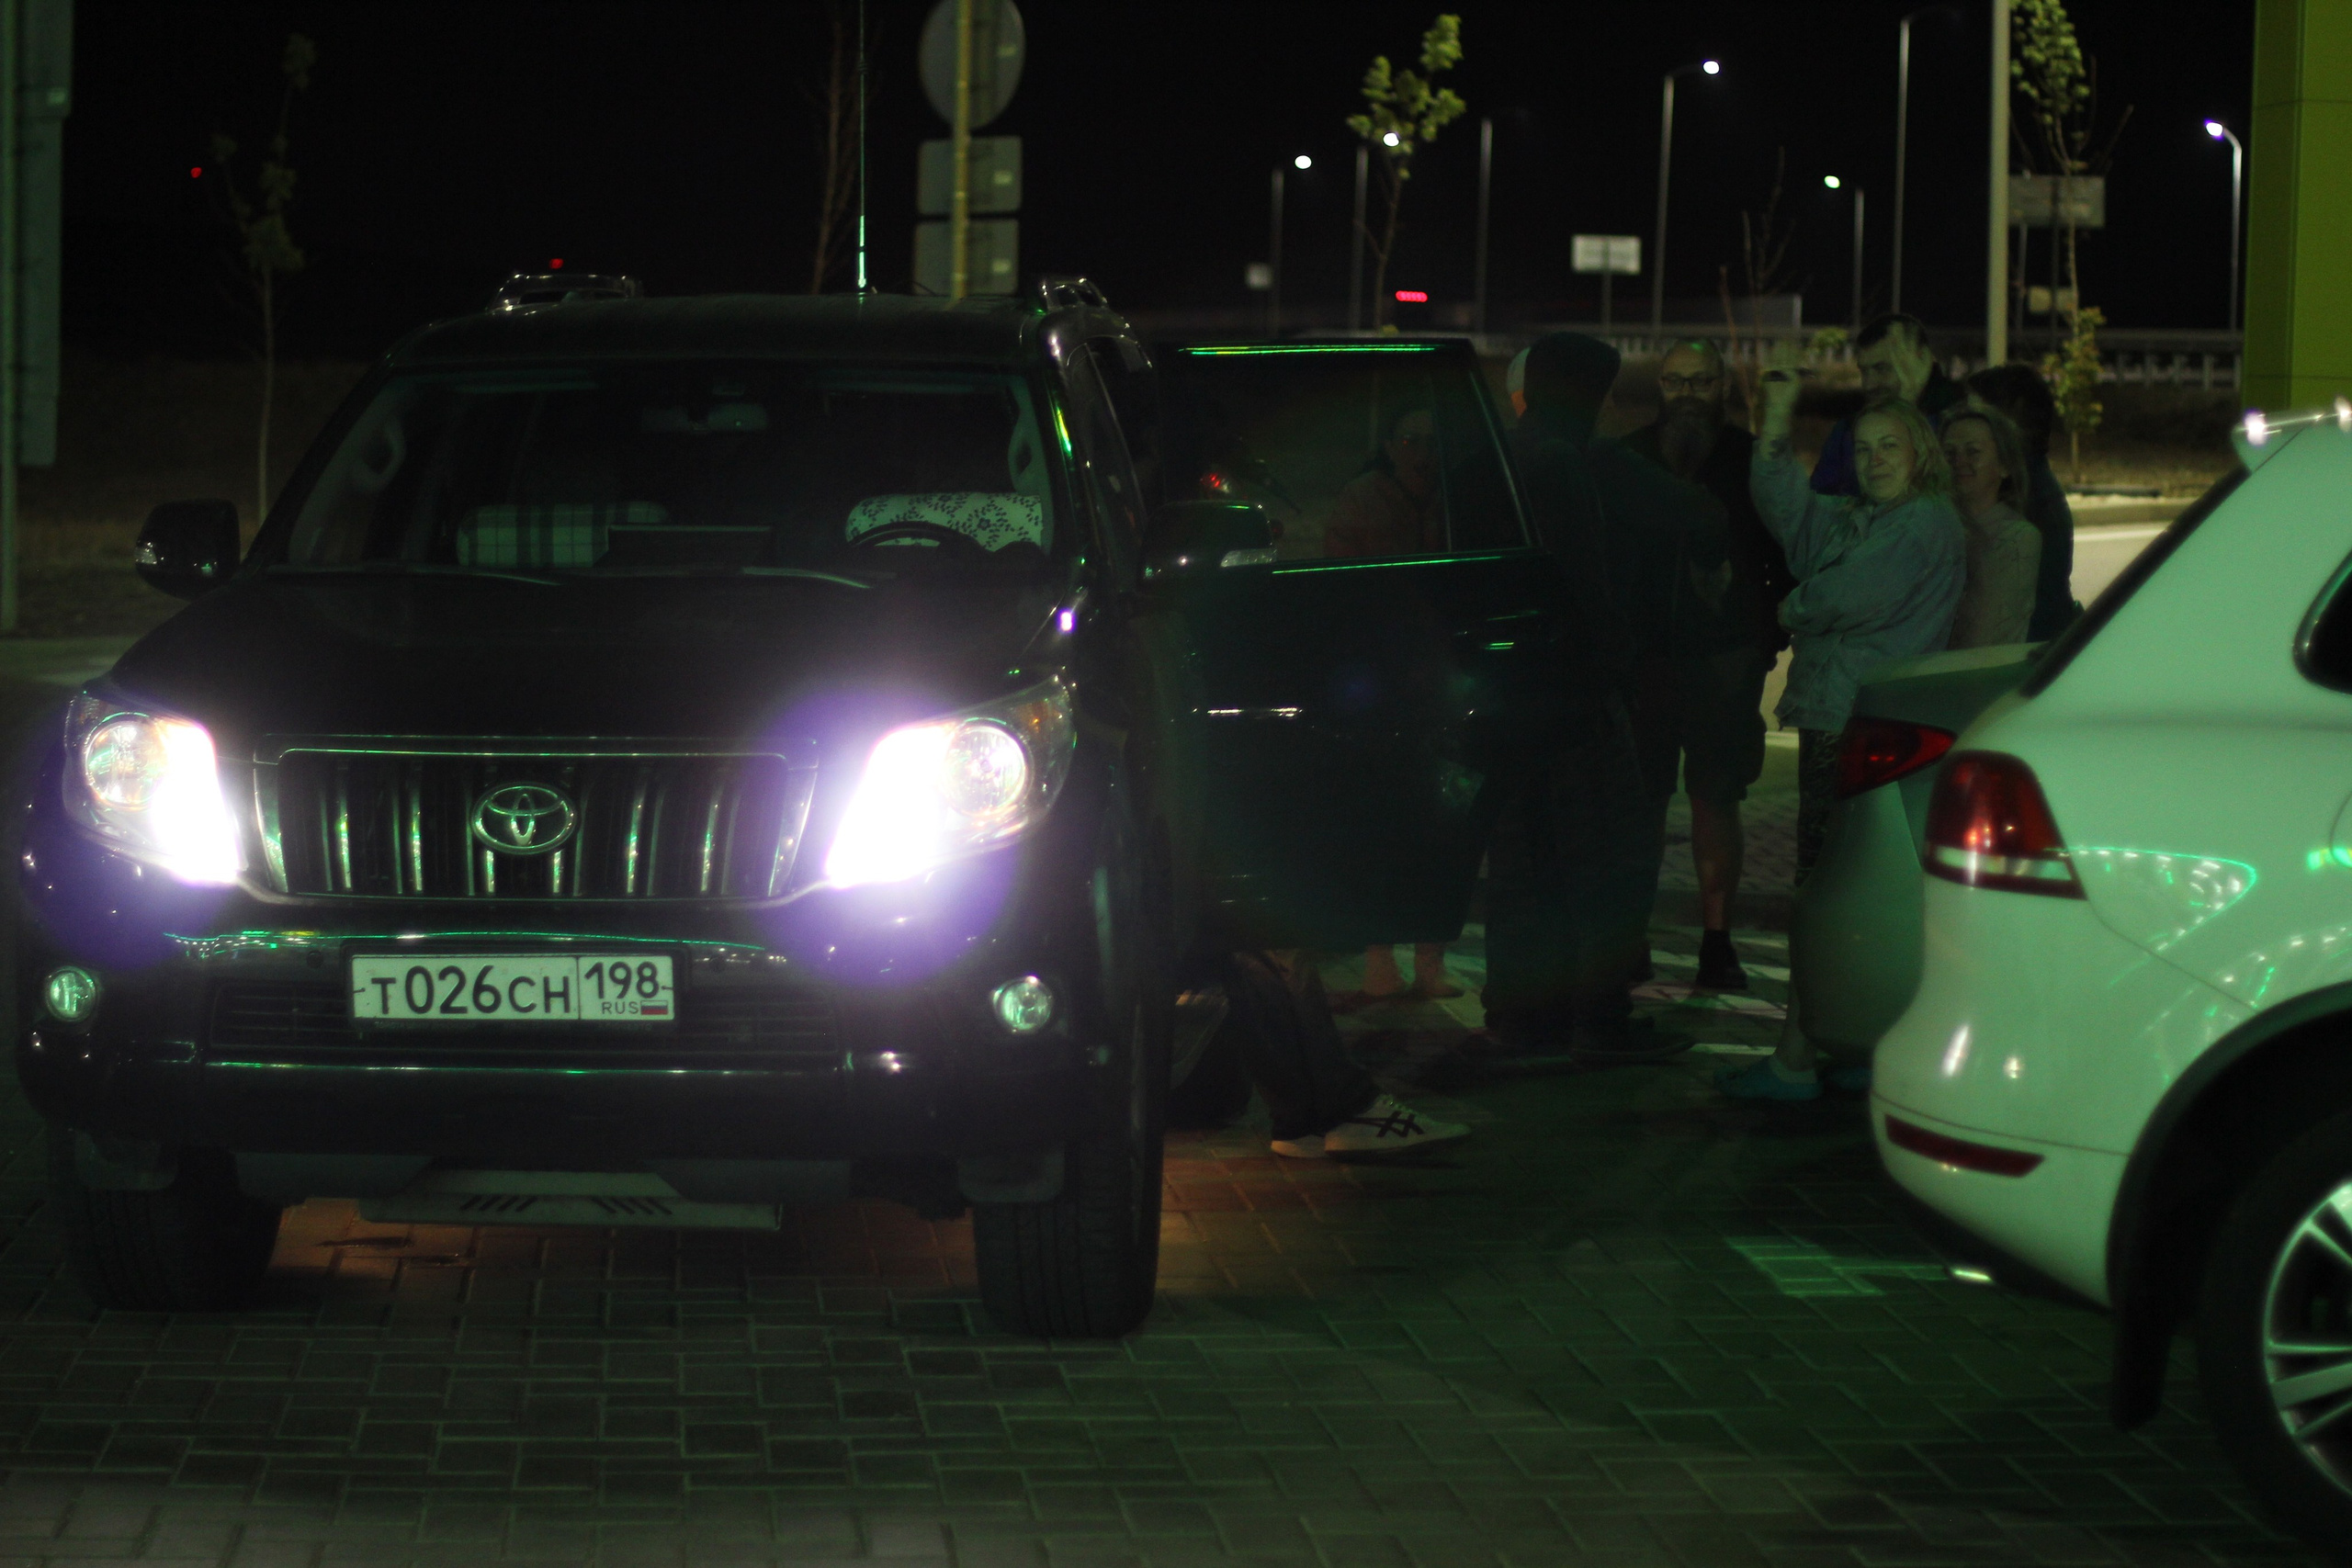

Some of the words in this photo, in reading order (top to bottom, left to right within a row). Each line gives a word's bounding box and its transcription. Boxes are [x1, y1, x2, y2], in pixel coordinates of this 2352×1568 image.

[370, 964, 571, 1015] T026CH
[584, 961, 660, 999] 198
[601, 1000, 639, 1015] RUS
